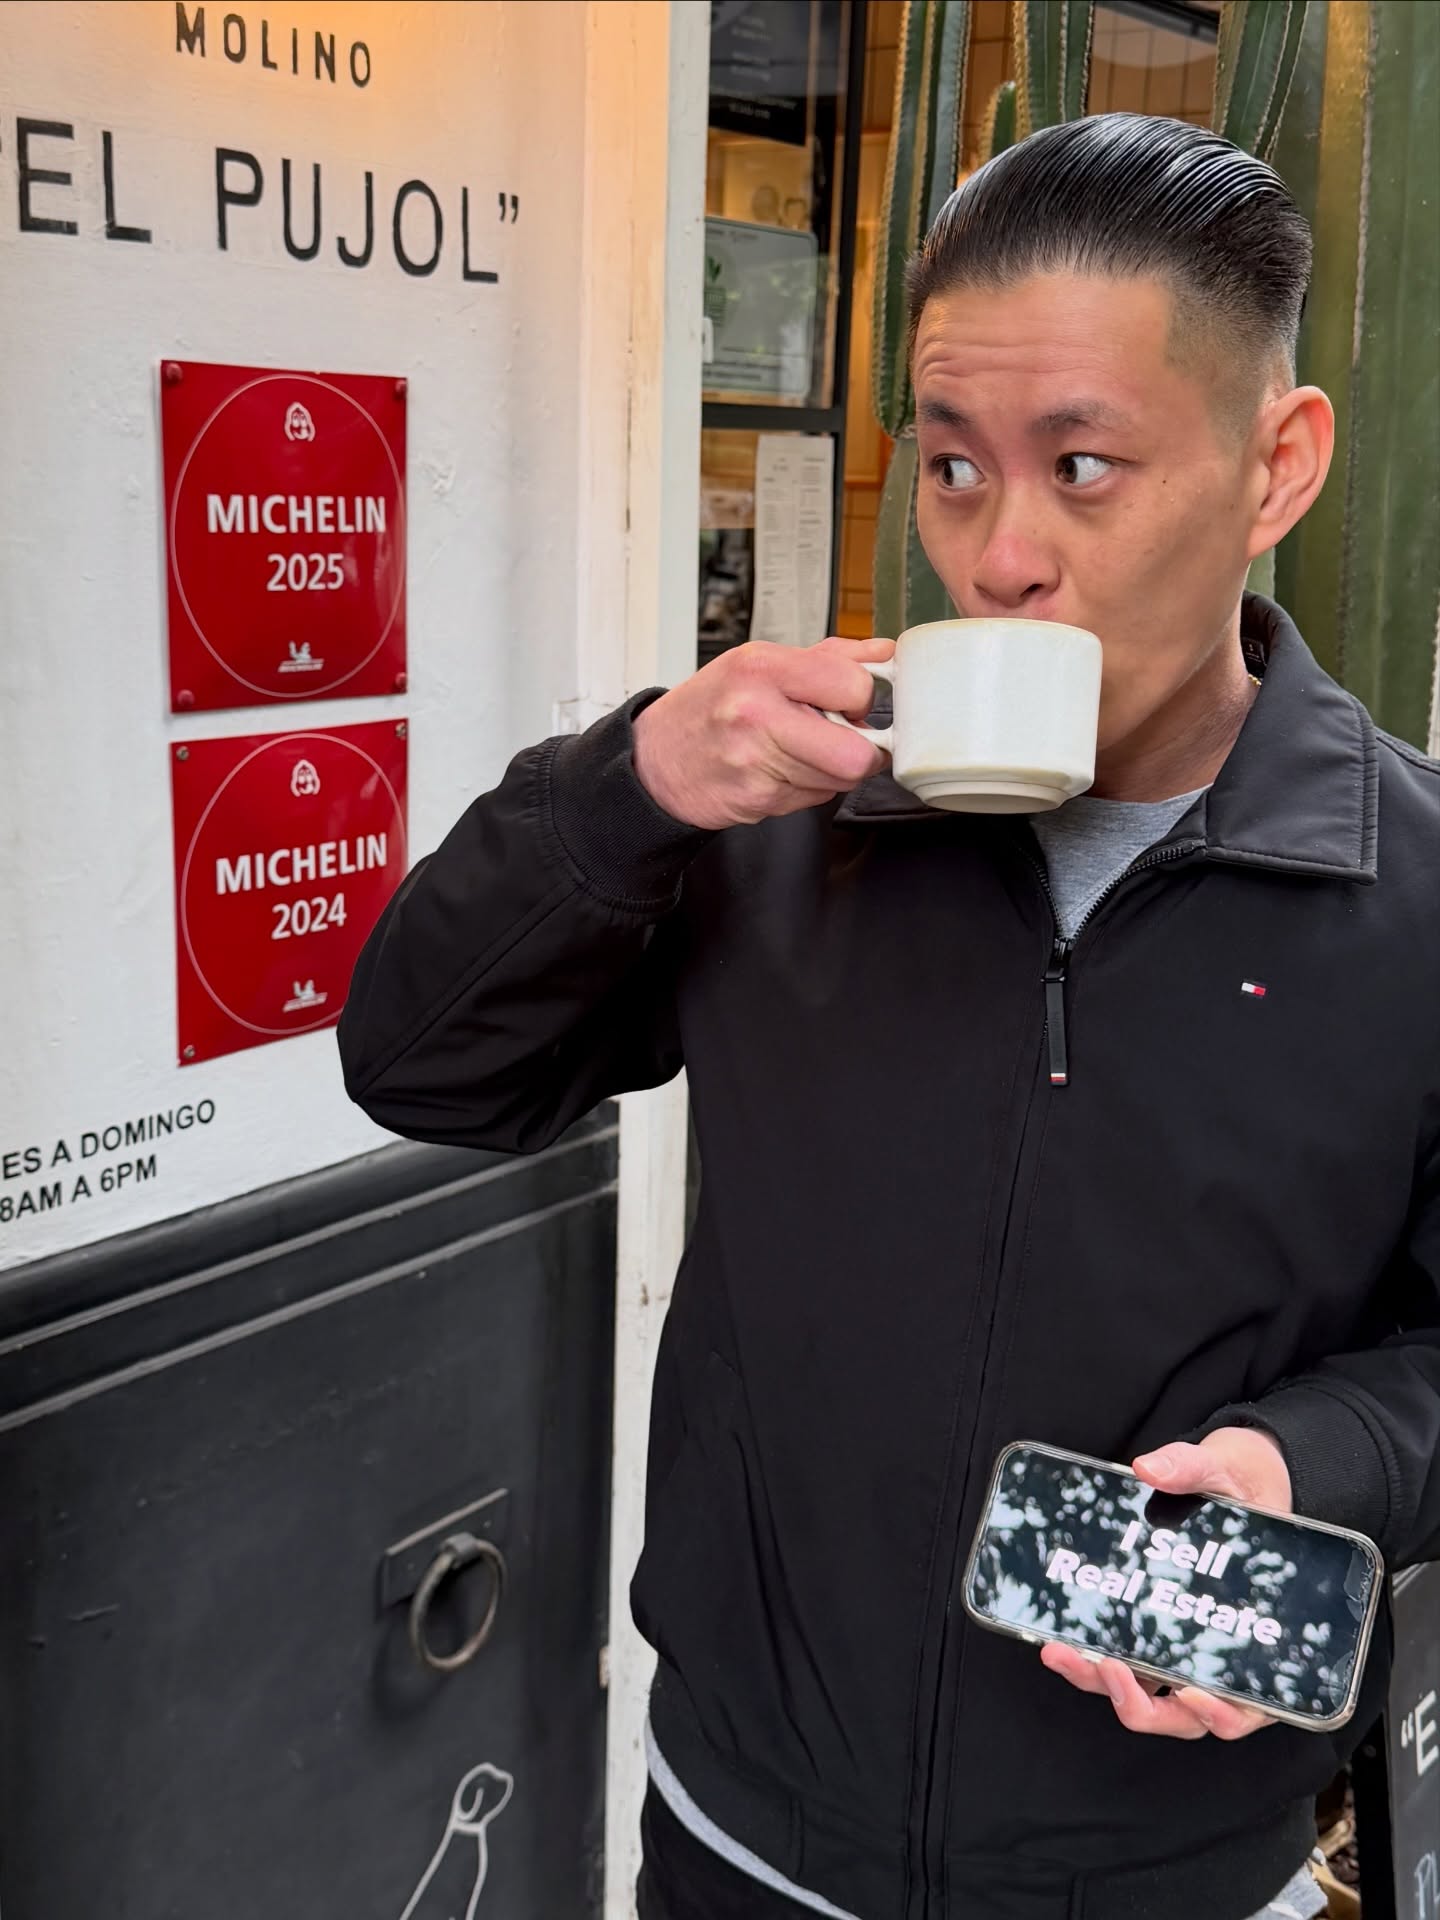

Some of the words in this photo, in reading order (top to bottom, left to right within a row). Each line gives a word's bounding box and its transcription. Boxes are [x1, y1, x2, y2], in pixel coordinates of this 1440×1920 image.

[176, 2, 371, 87] MOLINO
[0, 116, 152, 243] EL
[207, 494, 386, 533] MICHELIN
[267, 553, 345, 591] 2025
[216, 833, 387, 895] MICHELIN
[271, 893, 347, 940] 2024
[2, 1147, 42, 1181] ES
[51, 1139, 72, 1167] A
[81, 1099, 216, 1159] DOMINGO
[0, 1182, 62, 1223] 8AM
[72, 1175, 92, 1203] A
[100, 1154, 157, 1193] 6PM
[1119, 1521, 1143, 1551] I
[1143, 1528, 1233, 1579] Sell
[1045, 1547, 1146, 1603] Real
[1147, 1578, 1282, 1646] Estate
